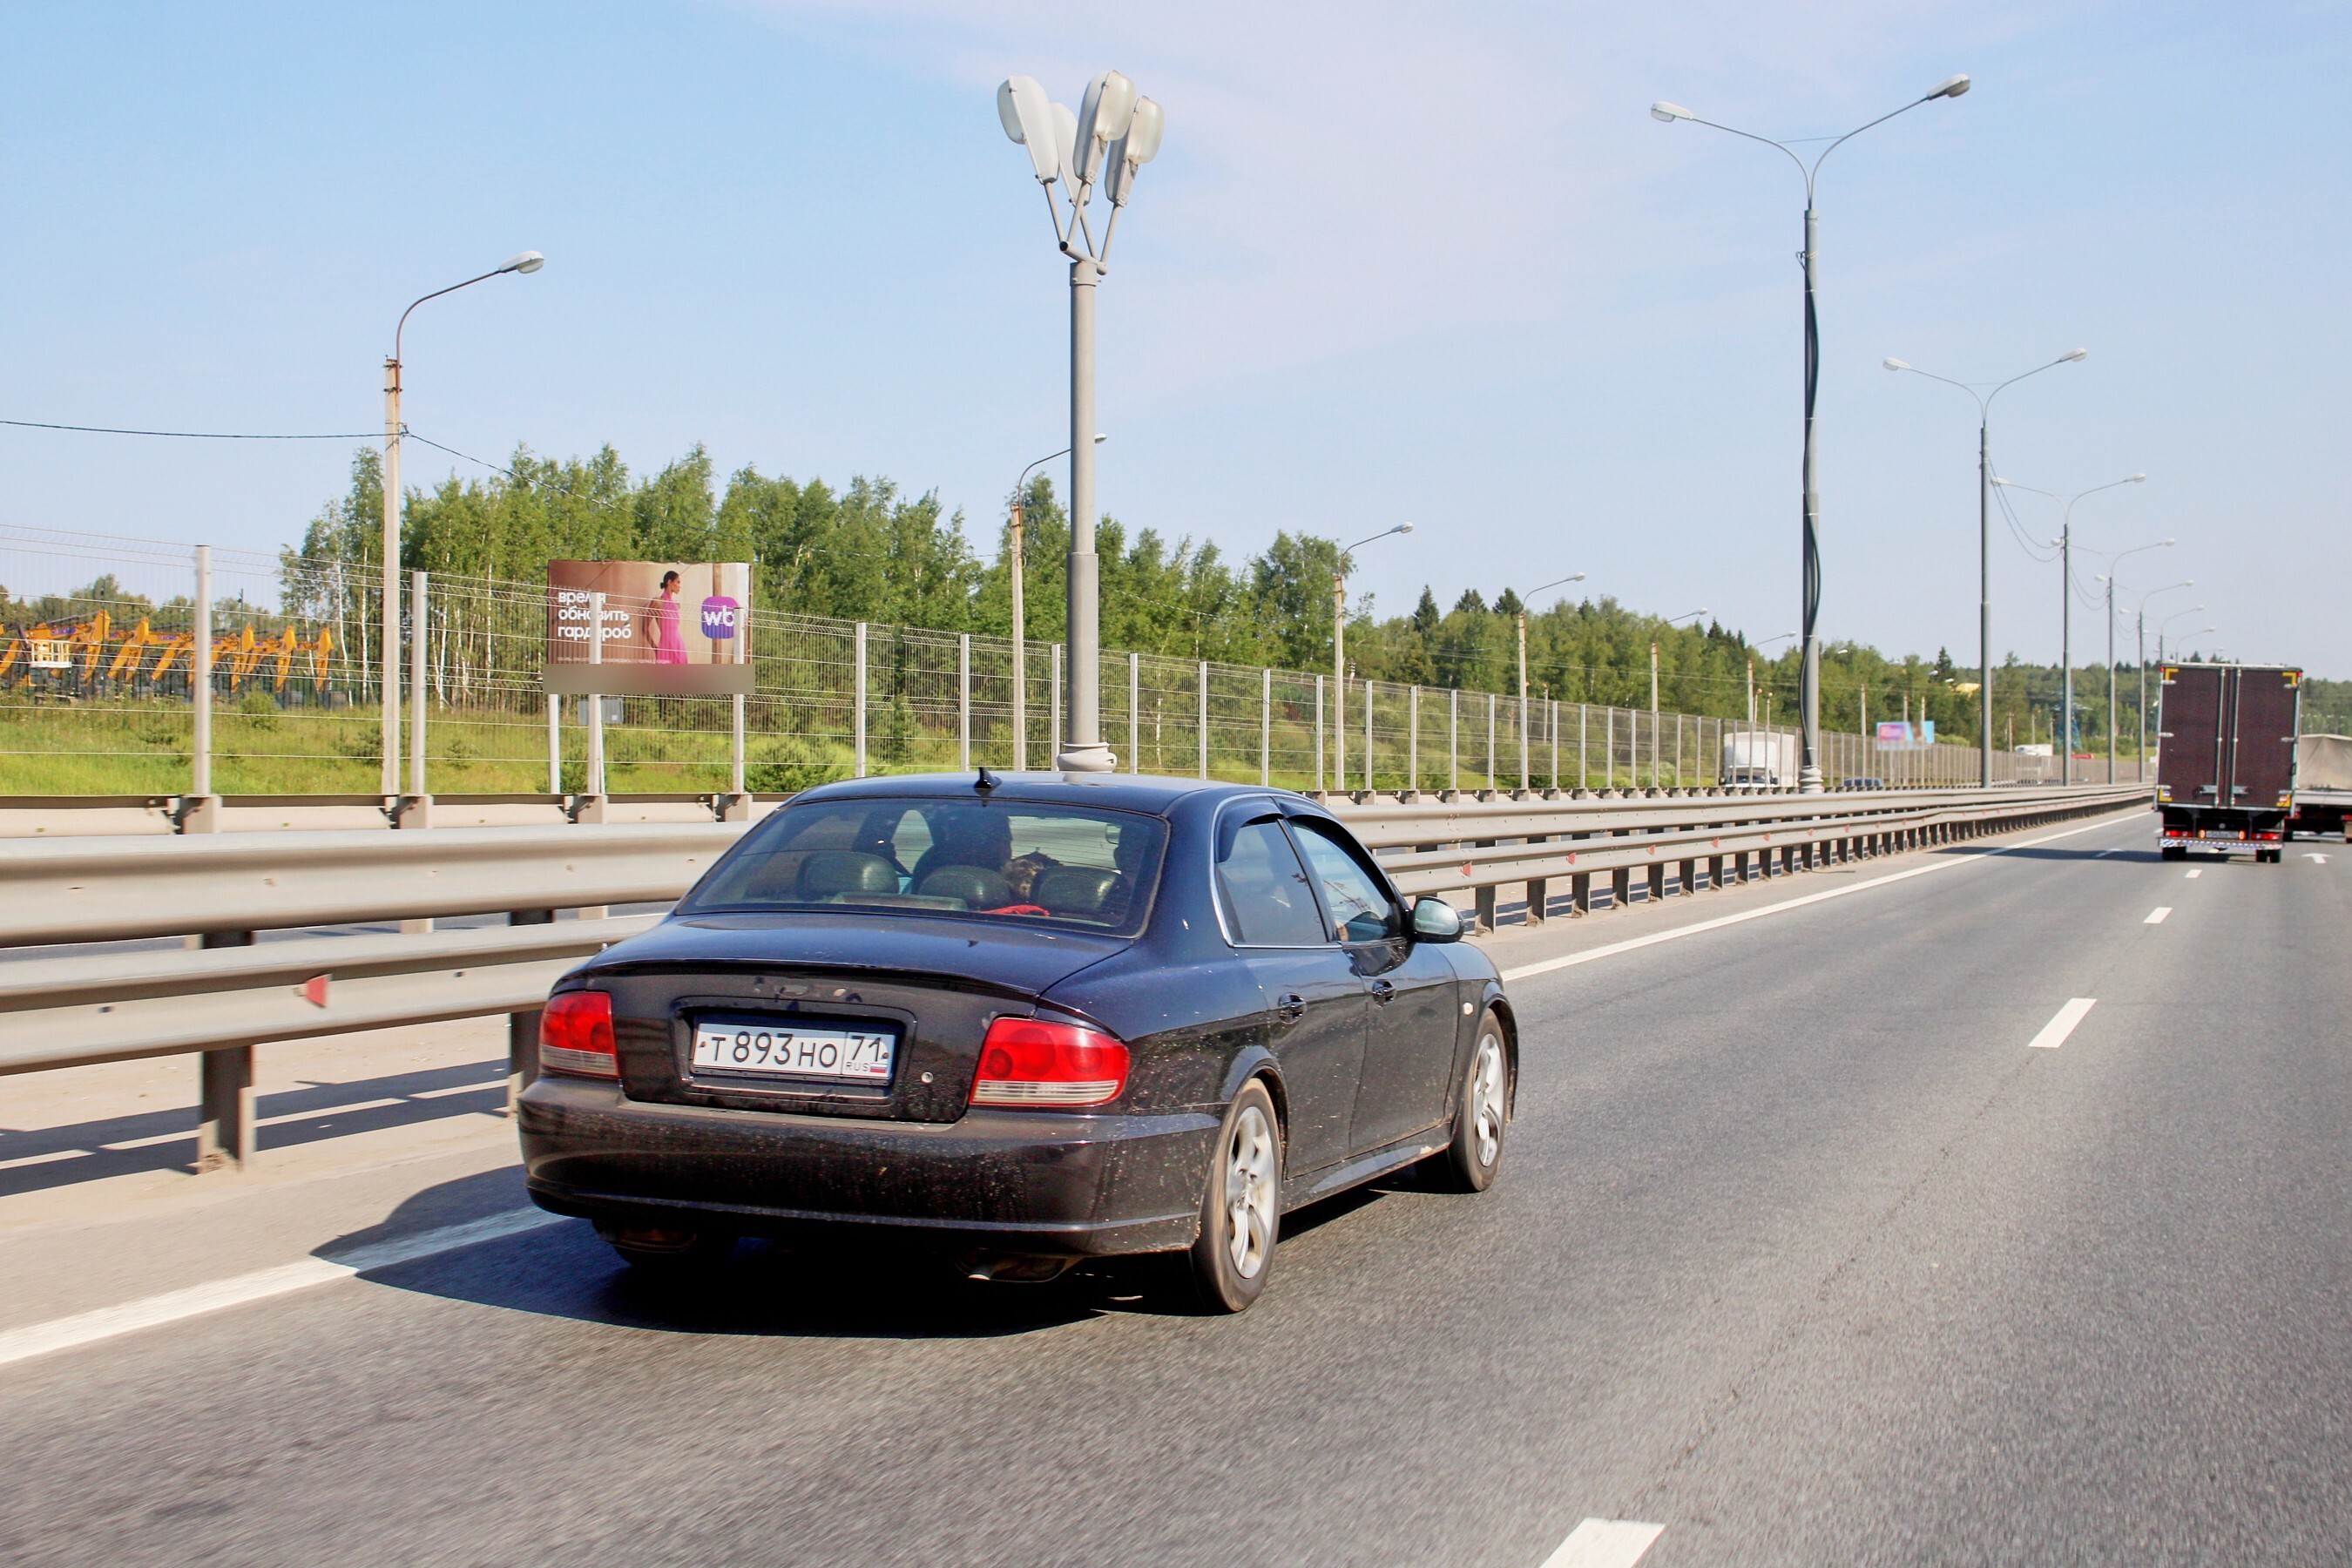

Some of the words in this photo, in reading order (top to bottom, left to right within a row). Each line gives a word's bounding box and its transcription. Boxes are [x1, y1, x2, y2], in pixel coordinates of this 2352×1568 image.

[703, 605, 734, 626] wb
[558, 624, 632, 641] гардроб
[851, 1035, 882, 1062] 71
[845, 1061, 869, 1072] RUS
